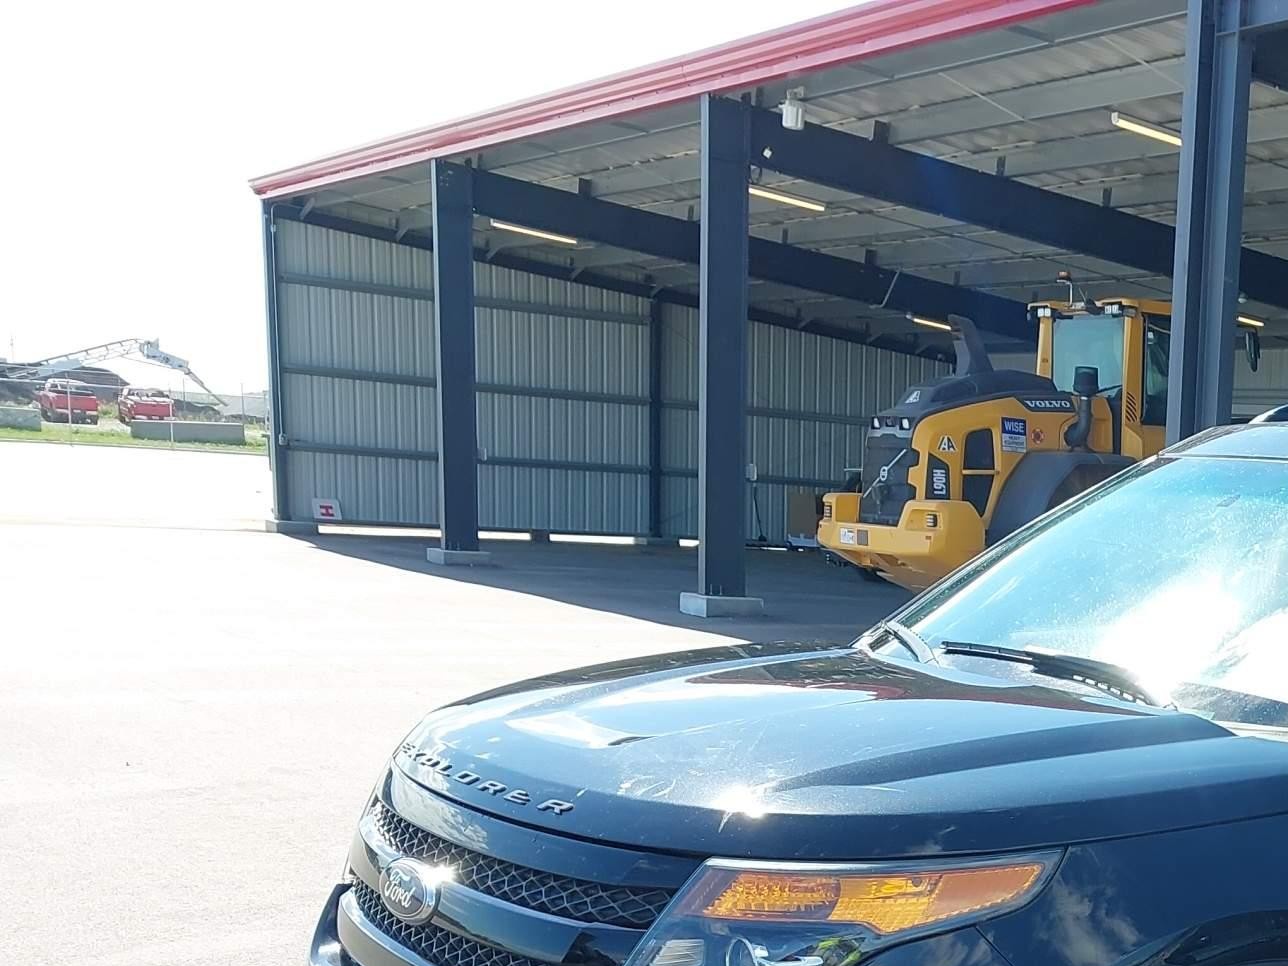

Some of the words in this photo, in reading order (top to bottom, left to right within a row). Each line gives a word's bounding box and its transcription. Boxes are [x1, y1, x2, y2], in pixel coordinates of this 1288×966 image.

[1024, 400, 1071, 408] VOLVO
[1004, 420, 1025, 433] WISE
[933, 469, 947, 495] L90H
[402, 742, 575, 816] EXPLORER
[384, 868, 416, 908] Ford
